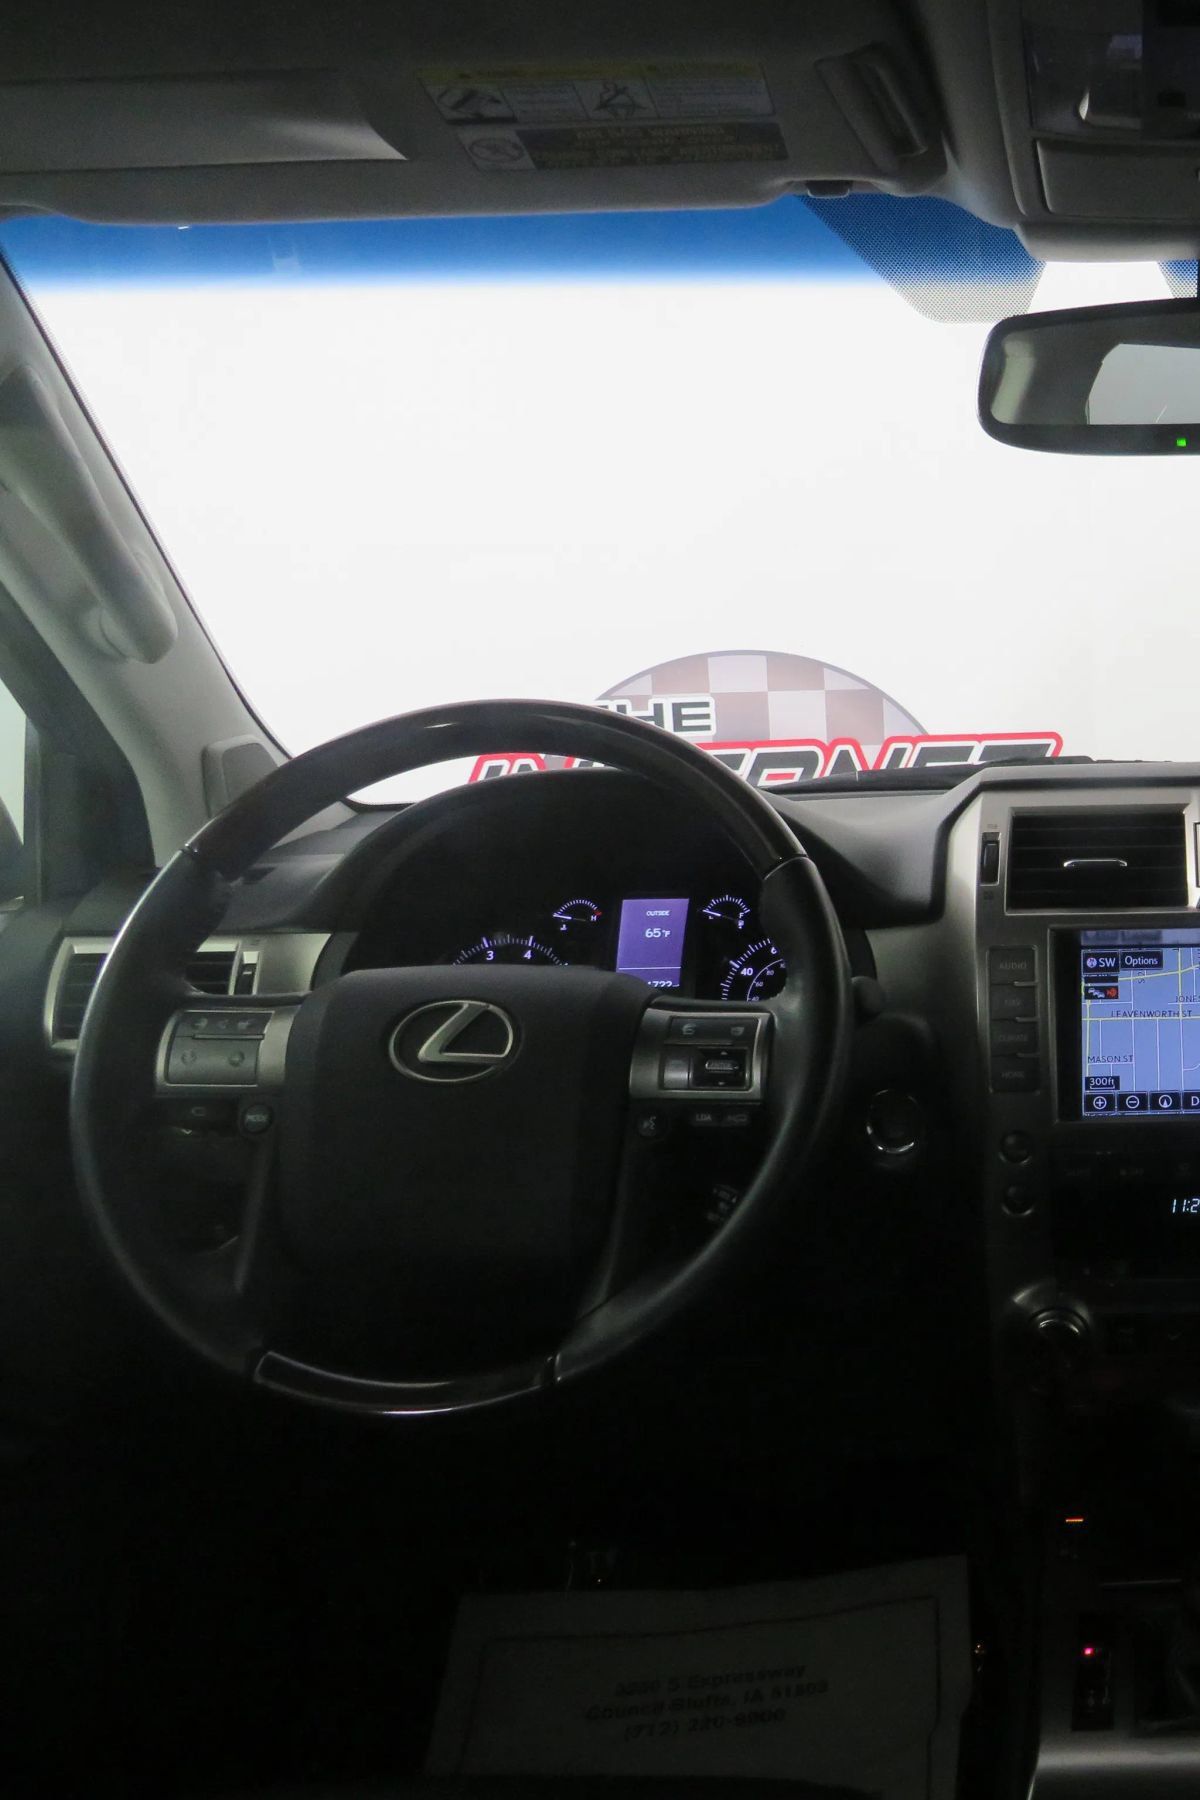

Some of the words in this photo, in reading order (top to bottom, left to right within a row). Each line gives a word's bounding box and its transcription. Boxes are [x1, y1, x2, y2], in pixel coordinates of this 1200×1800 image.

[485, 950, 494, 961] 3
[523, 950, 532, 960] 4
[1099, 957, 1116, 967] SW
[1124, 955, 1158, 967] Options
[740, 967, 753, 976] 40
[1111, 1010, 1179, 1018] LEAVENWORTH
[1087, 1055, 1122, 1063] MASON
[1089, 1077, 1114, 1086] 300ft
[743, 1688, 765, 1703] IA
